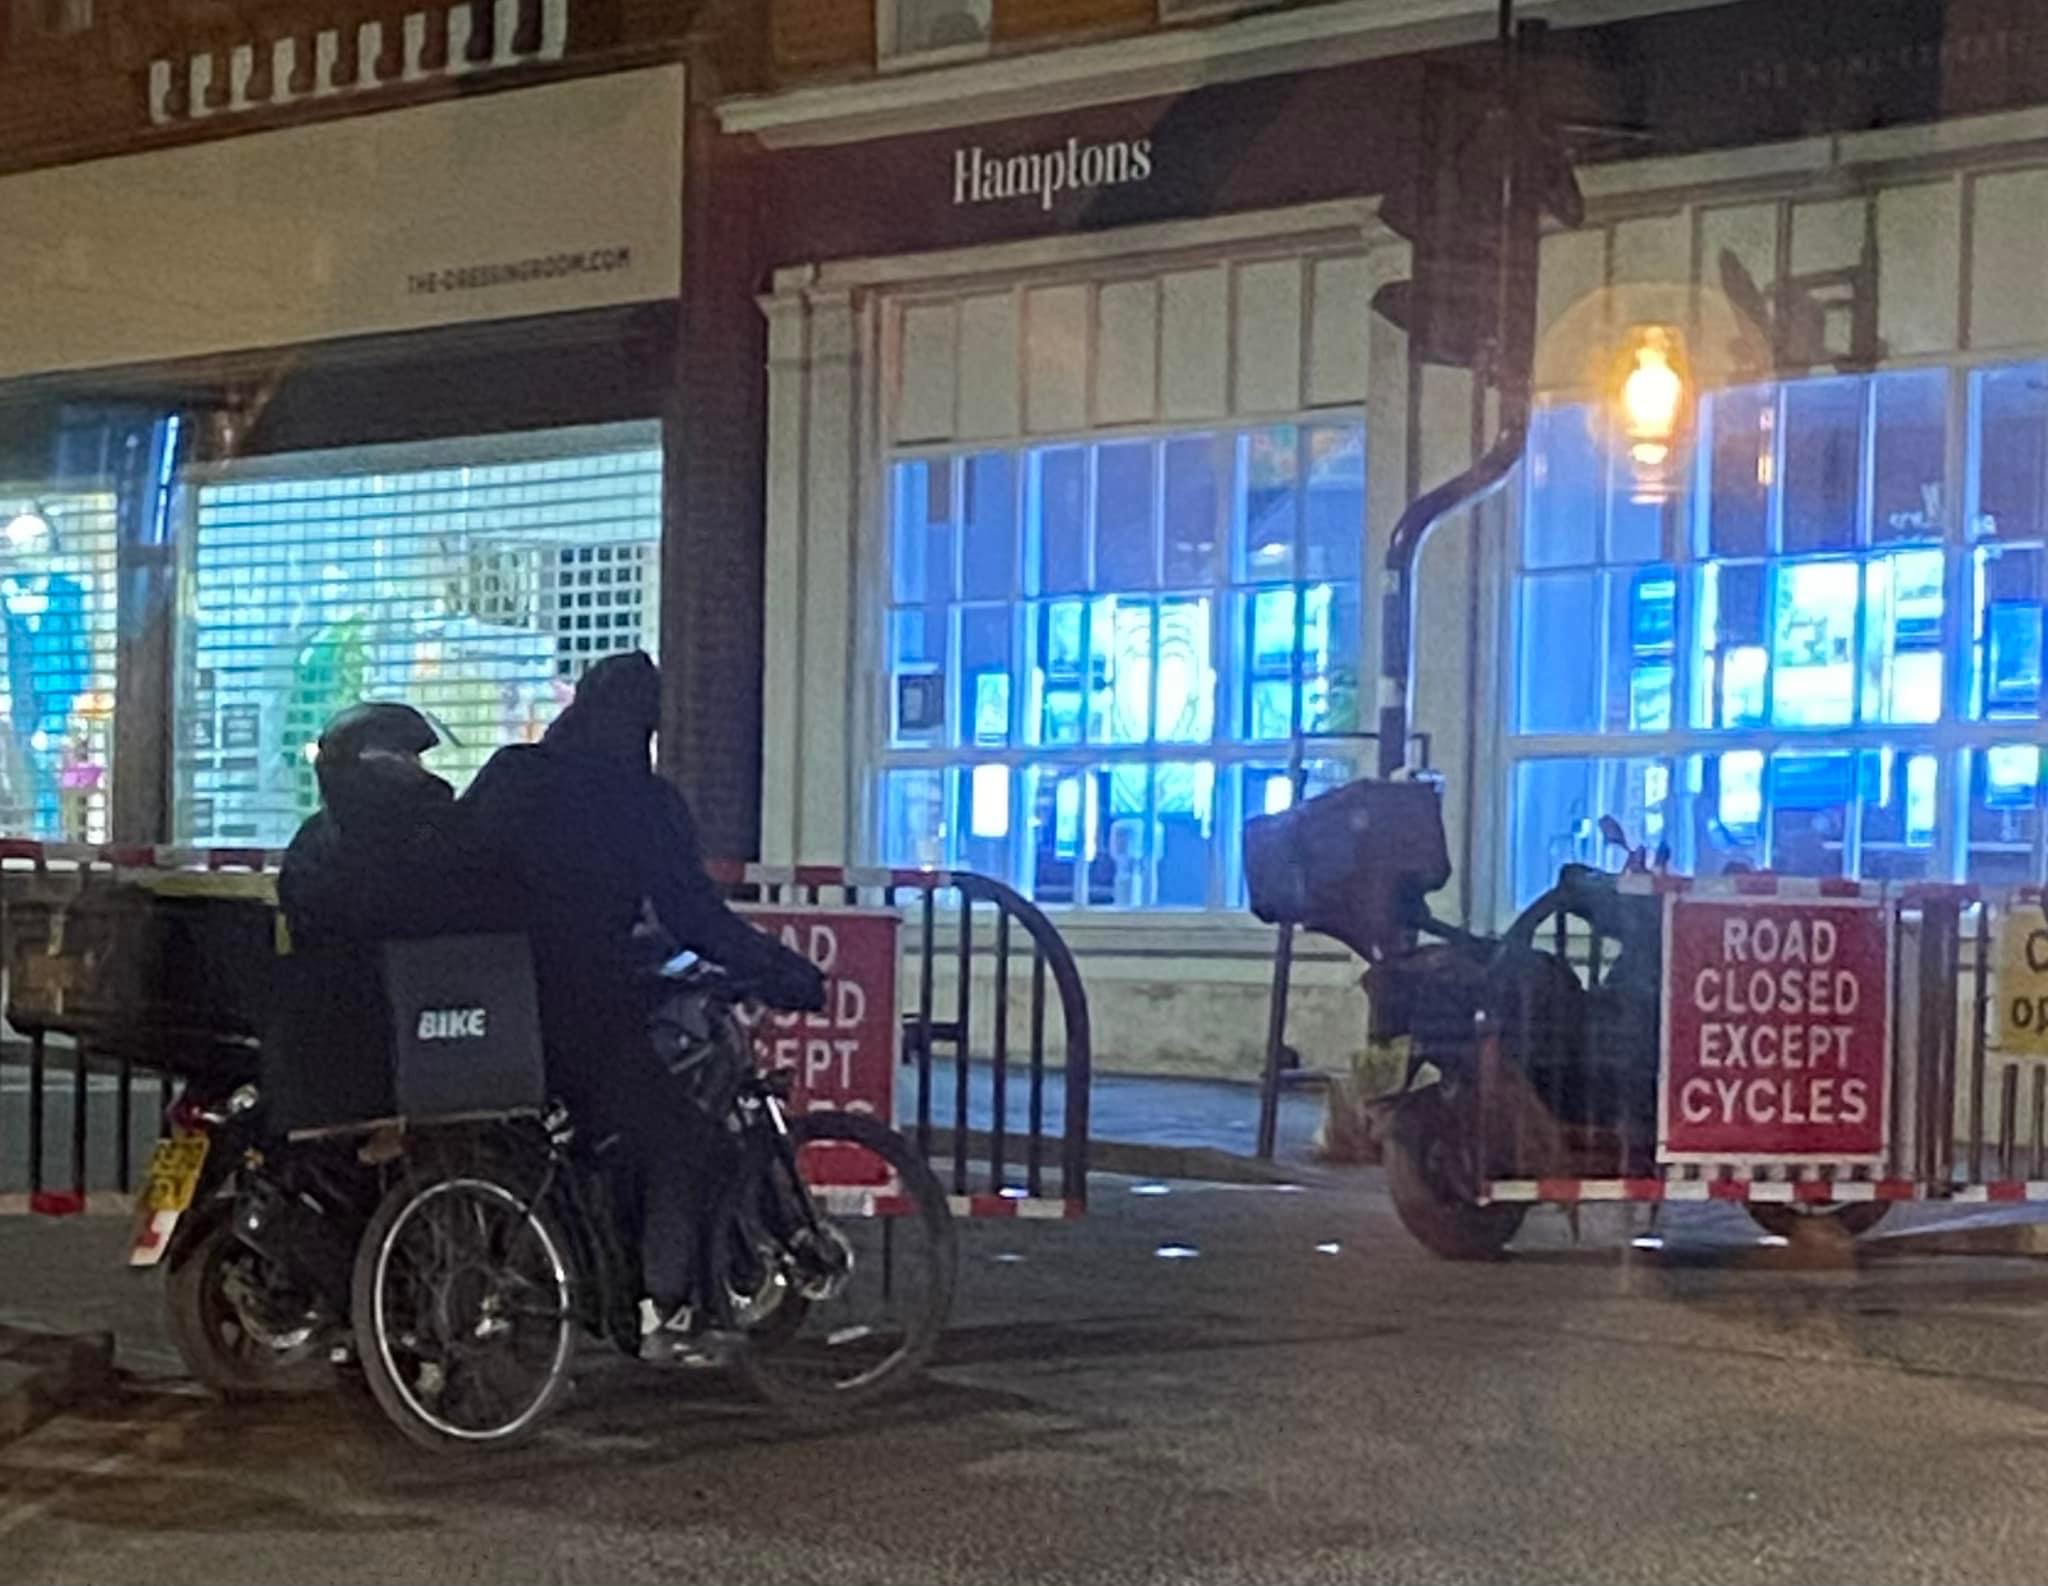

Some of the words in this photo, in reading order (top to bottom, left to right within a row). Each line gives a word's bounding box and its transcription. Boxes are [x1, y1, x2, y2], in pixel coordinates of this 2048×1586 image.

[953, 137, 1152, 211] Hamptons
[1722, 917, 1837, 965] ROAD
[1693, 968, 1860, 1015] CLOSED
[418, 1008, 486, 1039] BIKE
[1700, 1023, 1854, 1068] EXCEPT
[1680, 1078, 1869, 1124] CYCLES
